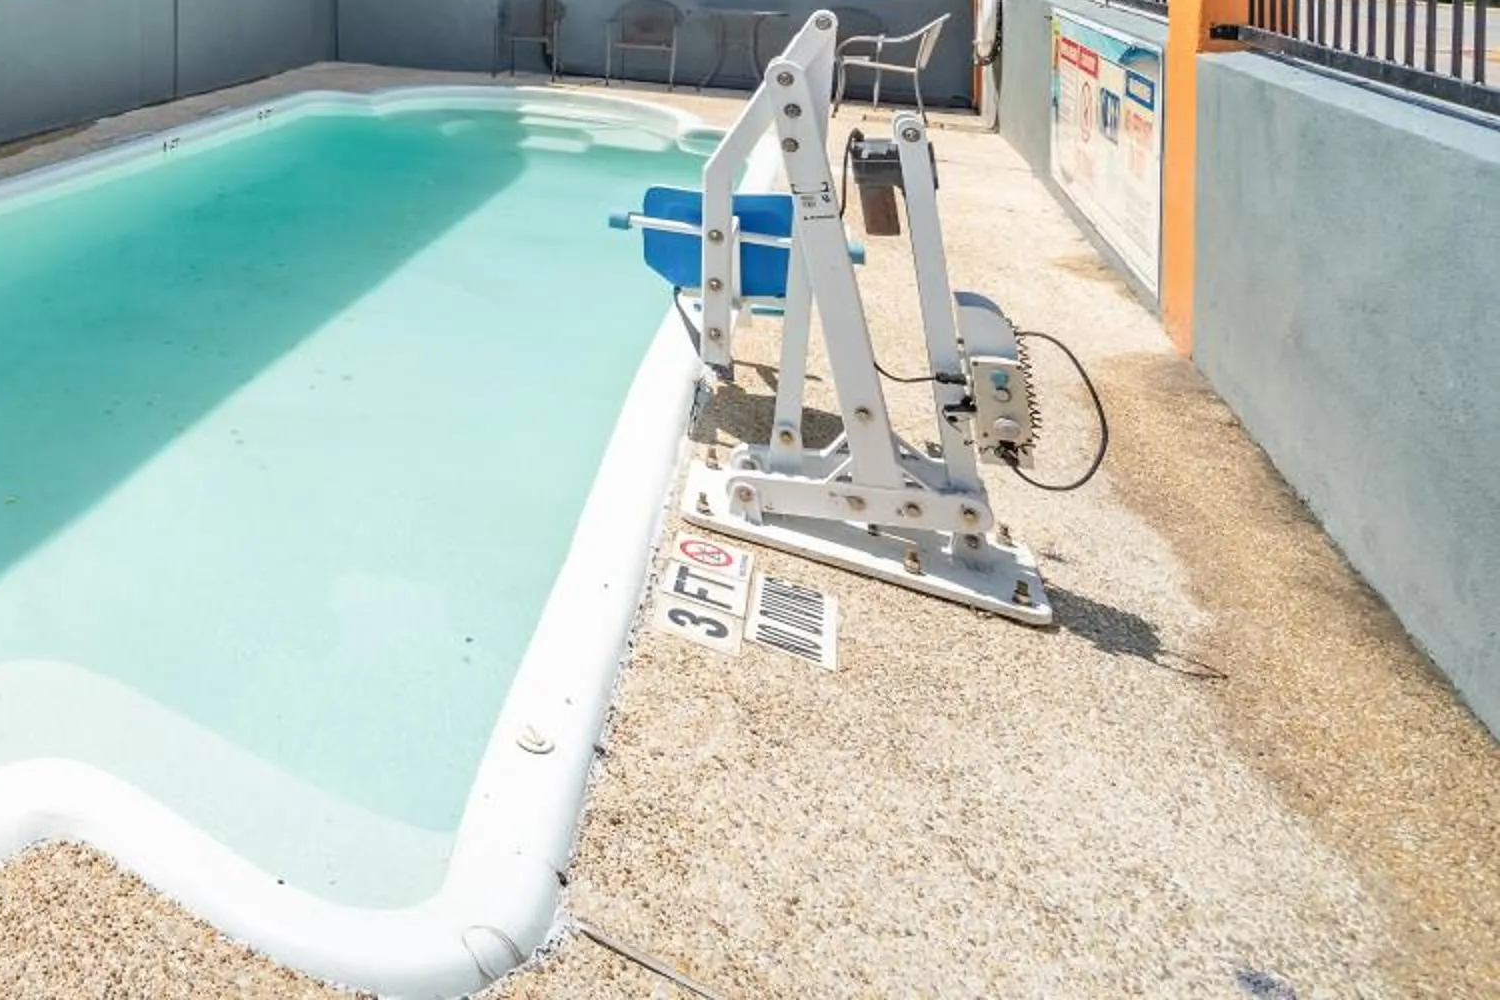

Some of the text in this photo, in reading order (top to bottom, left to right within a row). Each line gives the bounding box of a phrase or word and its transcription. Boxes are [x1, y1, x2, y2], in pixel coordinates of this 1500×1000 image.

[667, 565, 736, 639] 3 FT
[756, 577, 825, 663] NO DIVING
